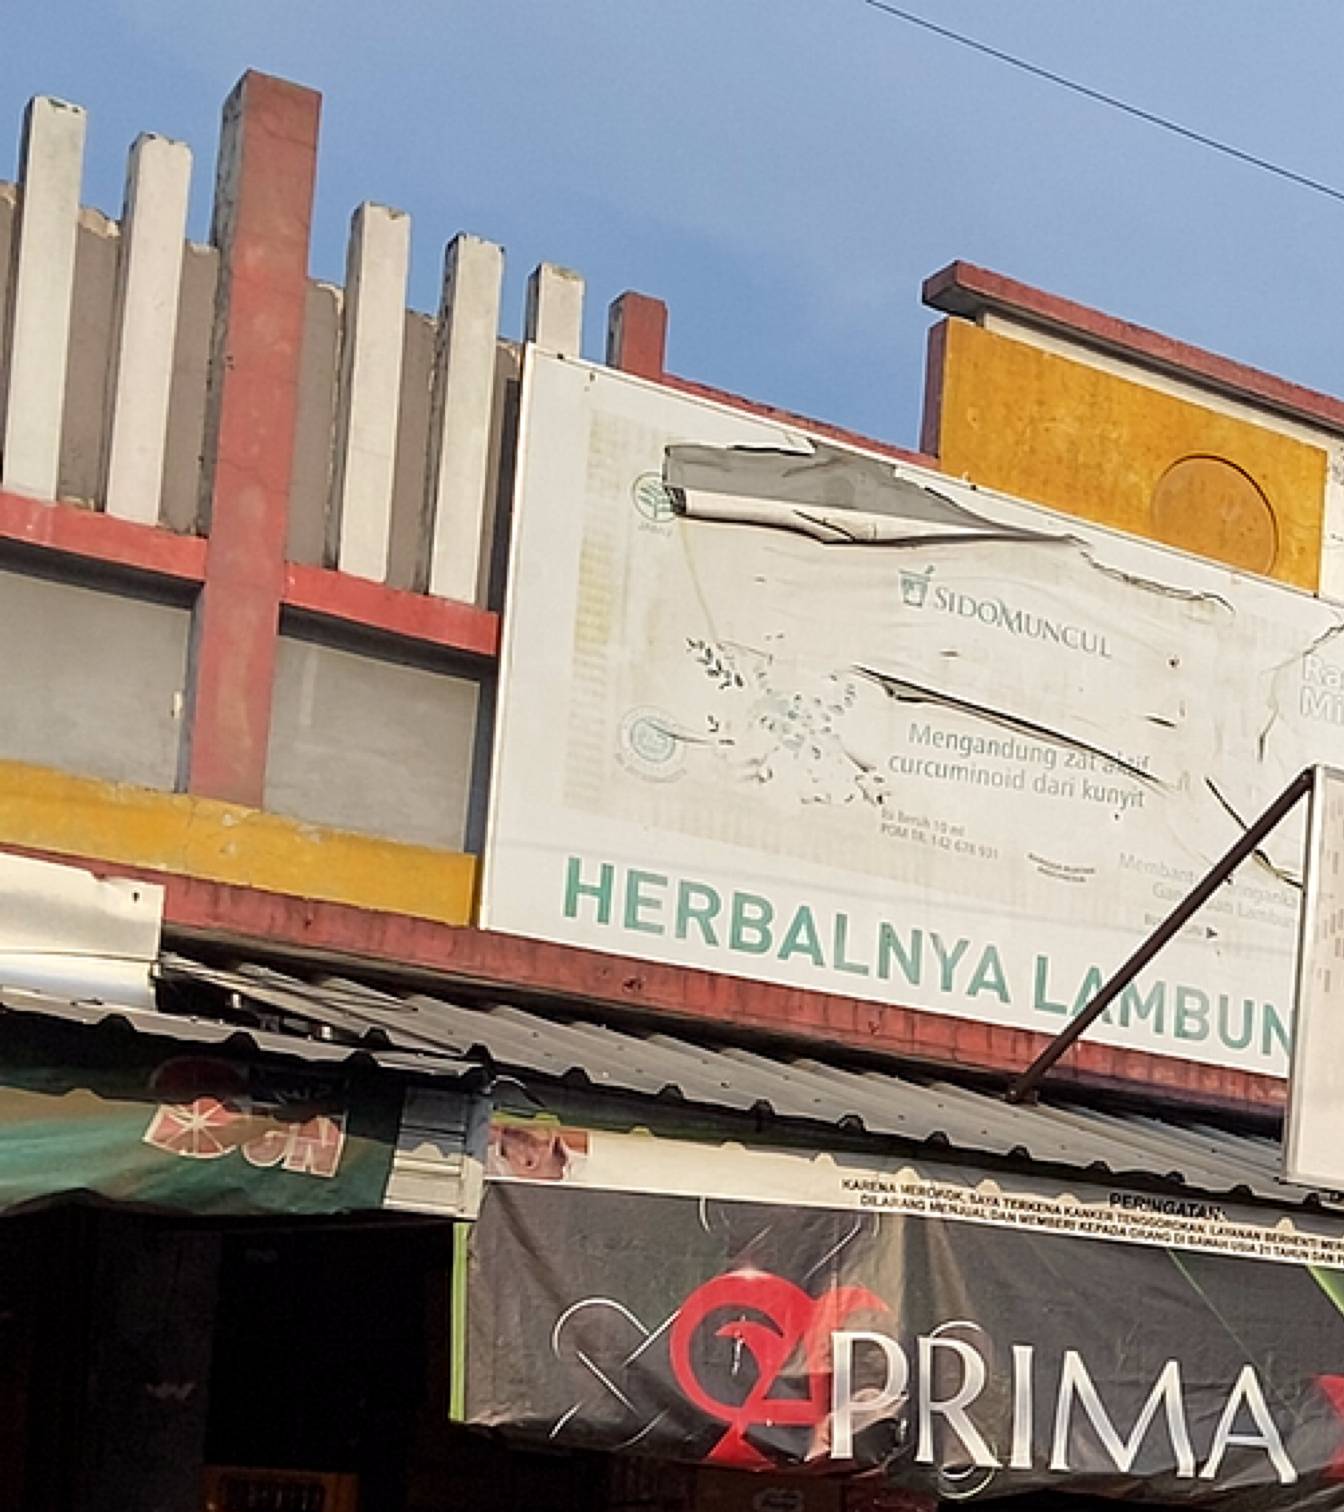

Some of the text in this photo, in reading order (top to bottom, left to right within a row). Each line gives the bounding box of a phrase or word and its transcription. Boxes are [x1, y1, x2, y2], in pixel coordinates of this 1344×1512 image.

[907, 722, 1057, 769] Mengandung
[888, 753, 1146, 811] curcuminoid dari kunyit
[562, 855, 1012, 1005] HERBALNYA
[841, 1178, 896, 1194] KARENA
[828, 1329, 1298, 1485] PRIMA
